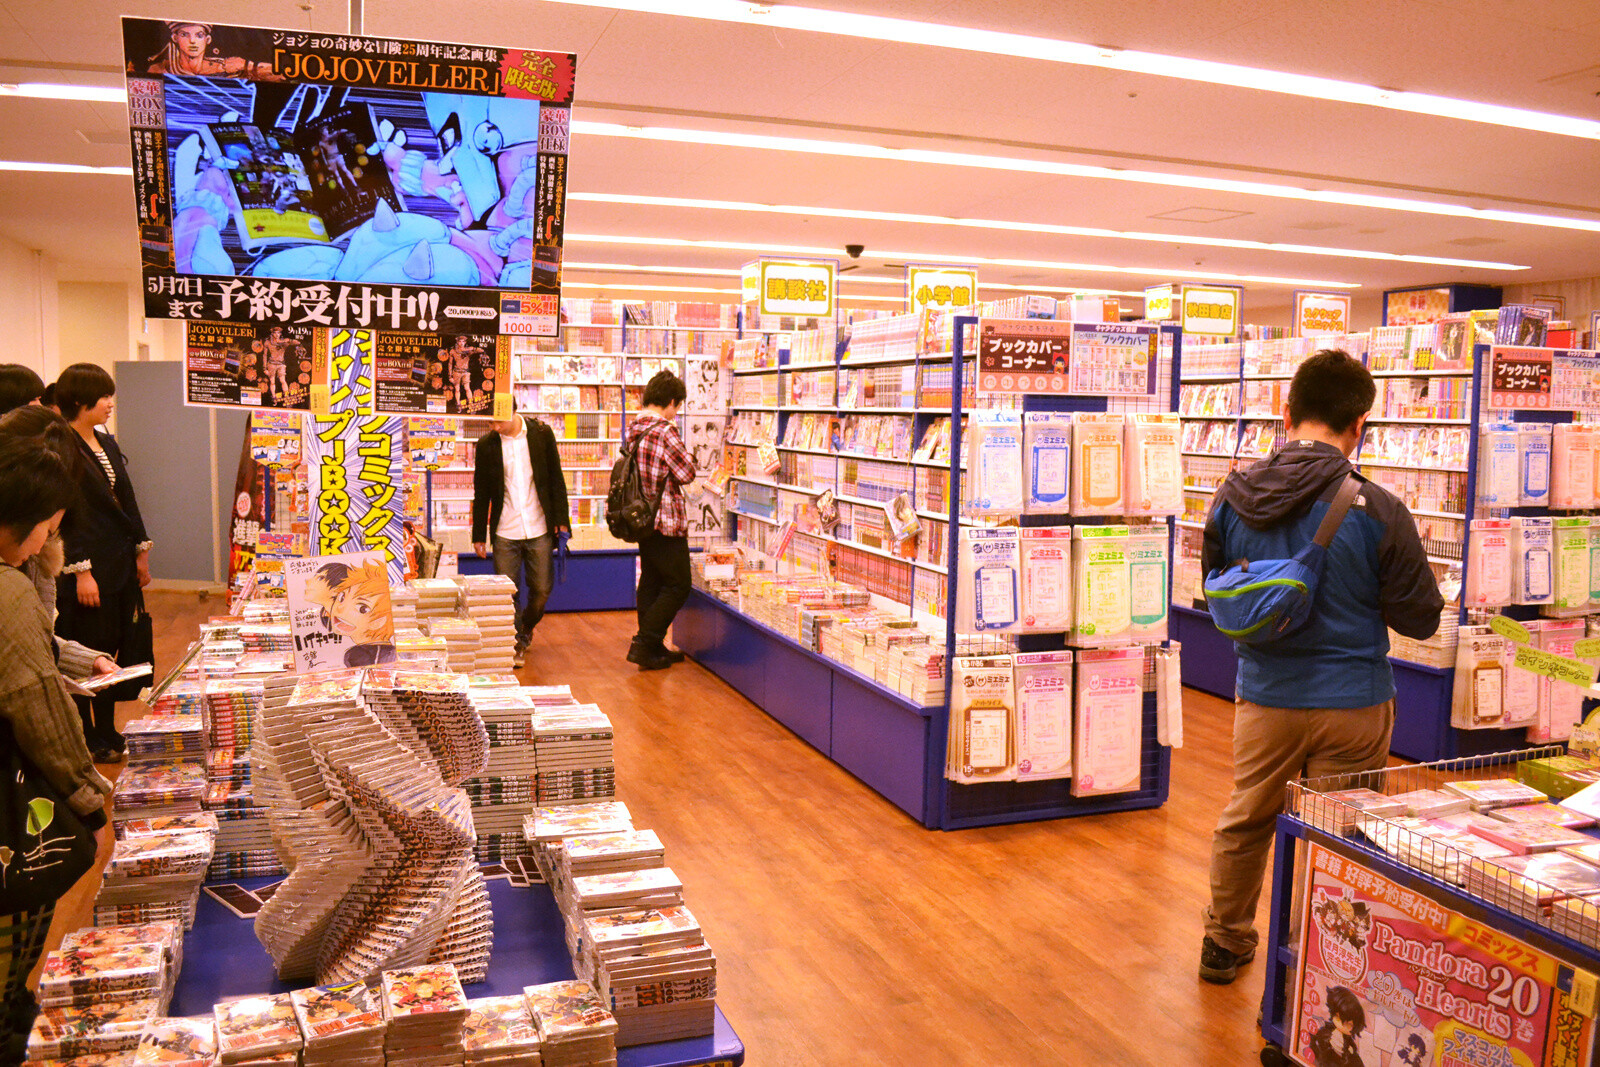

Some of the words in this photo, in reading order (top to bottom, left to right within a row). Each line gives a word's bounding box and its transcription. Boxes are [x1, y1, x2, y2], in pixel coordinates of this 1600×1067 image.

[272, 32, 498, 62] ジョジョの奇妙な冒険25周年記念画集
[520, 50, 557, 78] 完全
[504, 66, 559, 100] 限定版
[129, 96, 162, 110] BOX
[540, 124, 567, 138] BOX
[148, 276, 203, 297] 5月7日
[767, 278, 827, 300] 講談社
[916, 285, 970, 306] 小学館
[168, 299, 204, 318] まで
[1186, 302, 1233, 319] 秋田書店
[1304, 308, 1342, 319] スクウェア
[504, 322, 532, 333] 1000
[989, 338, 1062, 354] ブックカバー
[1102, 334, 1148, 345] ブックカバー
[1001, 355, 1046, 369] コーナー
[1498, 363, 1547, 376] ブックカバー
[1505, 377, 1536, 389] コーナー
[987, 675, 1010, 683] ミエミエ
[1034, 677, 1064, 688] ミエミエ
[1101, 677, 1137, 689] ミエミエ
[1315, 850, 1343, 877] 書籍
[1344, 863, 1449, 930] 好評予約受付中!
[1464, 925, 1540, 973] コミックス
[1372, 921, 1489, 989] Pandora
[1487, 965, 1541, 1017] 20
[1415, 975, 1512, 1039] Hearts
[1513, 1017, 1535, 1043] 巻
[1453, 1028, 1514, 1061] マスコット
